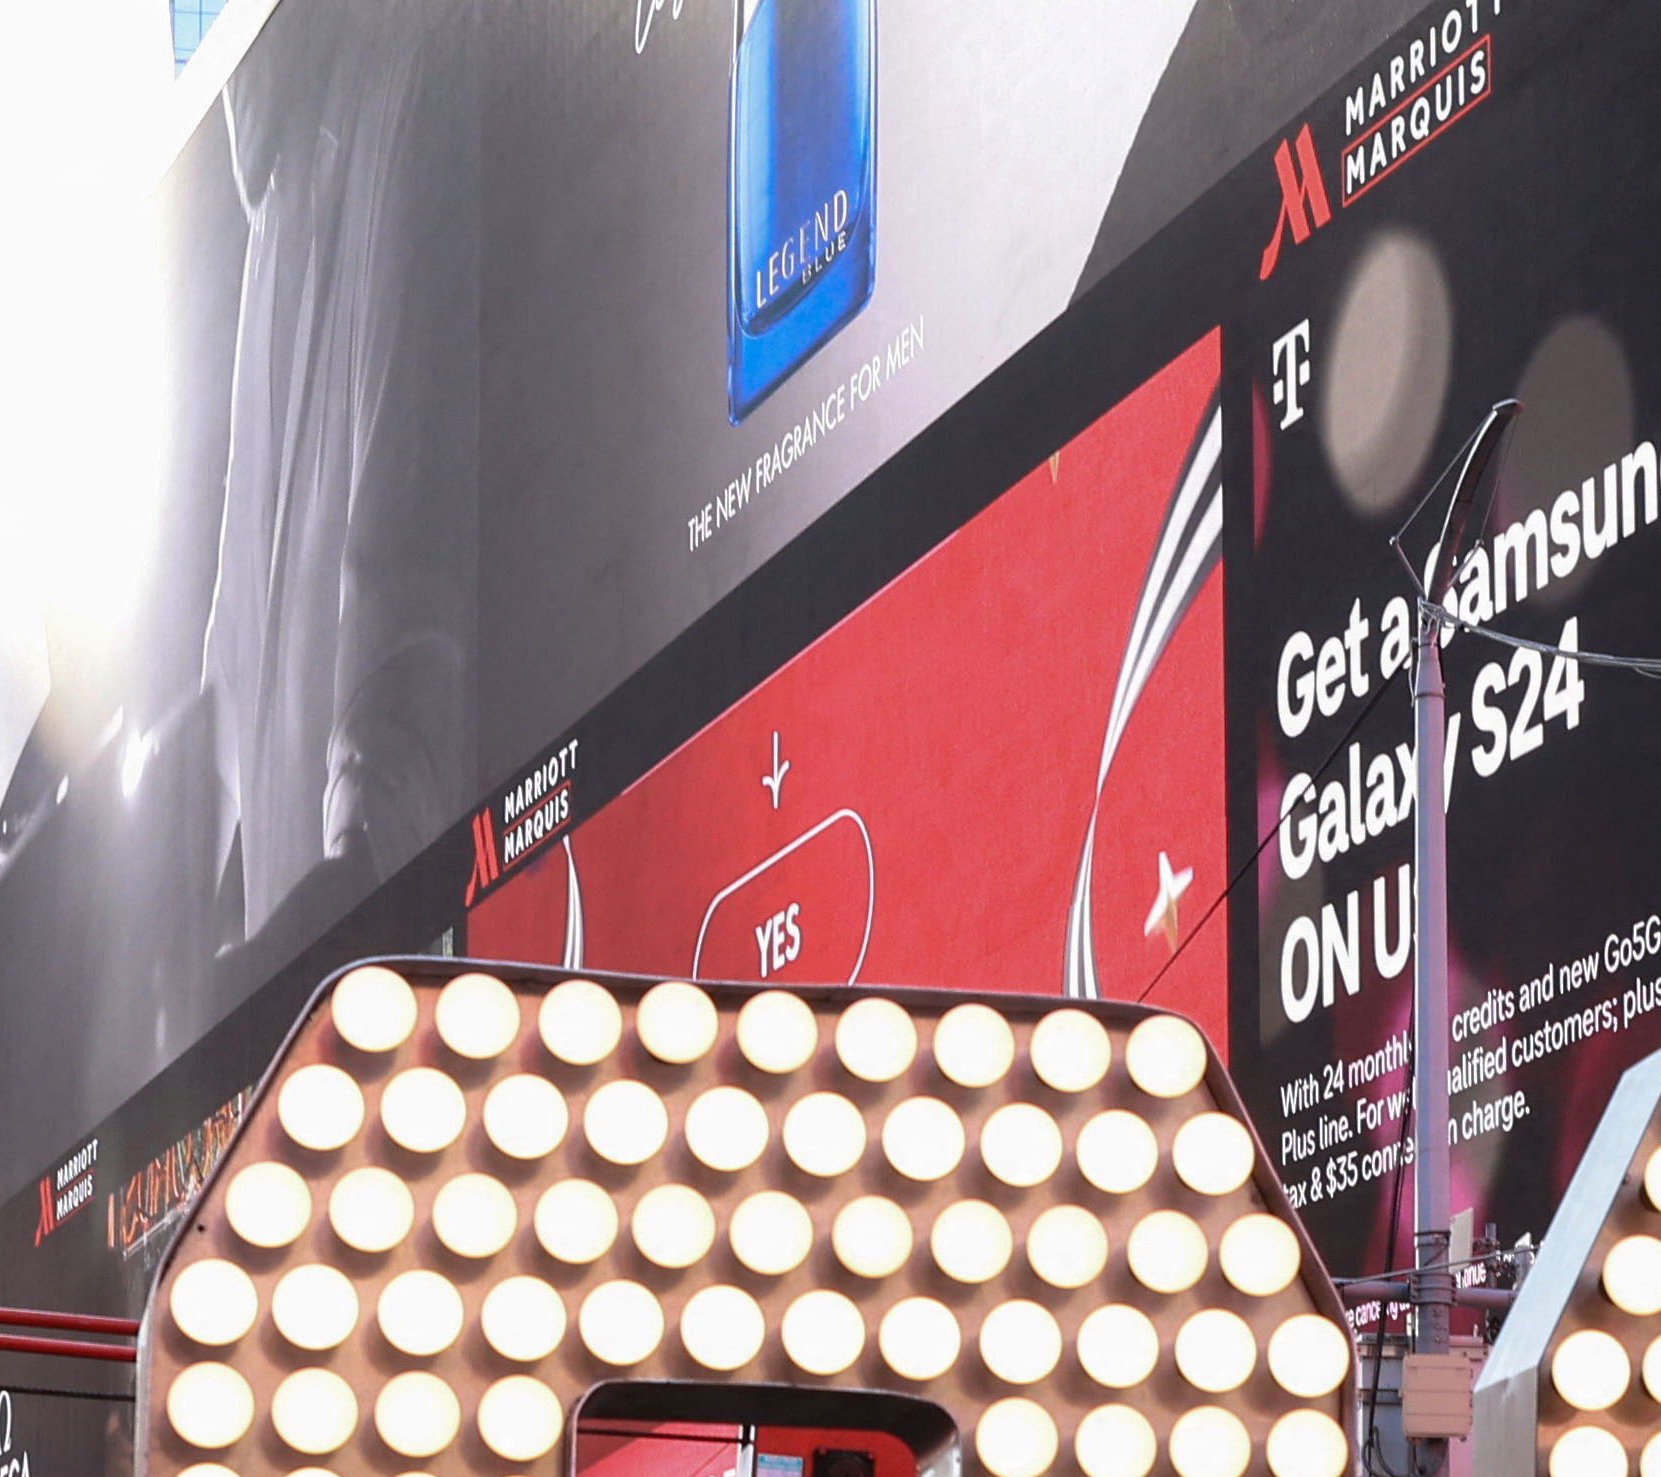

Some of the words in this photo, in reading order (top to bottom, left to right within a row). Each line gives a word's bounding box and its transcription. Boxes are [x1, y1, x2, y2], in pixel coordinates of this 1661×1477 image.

[1345, 0, 1502, 136] MARRIOT
[1345, 49, 1487, 195] MARQUIS
[755, 189, 848, 309] LEGEND
[802, 230, 847, 286] BLUE
[687, 502, 713, 553] THE
[715, 466, 752, 529] NEW
[755, 384, 846, 494] FRAGRANCE
[850, 354, 881, 412] FOR
[886, 313, 924, 381] MEN
[1277, 597, 1370, 739] Get
[1379, 595, 1413, 681] a
[1470, 615, 1585, 778] S24
[504, 738, 579, 824] MARRIOTT
[504, 788, 570, 864] MARQUIS
[755, 902, 802, 978] YES
[1280, 889, 1360, 1024] ON
[1373, 863, 1417, 980] U
[1280, 1063, 1320, 1119] With
[1322, 1057, 1345, 1100] 24
[1348, 1030, 1412, 1089] monthl
[1452, 989, 1516, 1043] credits
[1519, 961, 1554, 1012] and
[1559, 951, 1600, 994] new
[1604, 914, 1661, 975] Go5G
[1281, 1122, 1316, 1168] Plus
[1319, 1113, 1353, 1148] line.
[1356, 1097, 1385, 1135] For
[1511, 1000, 1620, 1068] customers;
[1310, 1167, 1324, 1203] &
[1326, 1149, 1359, 1197] $35
[1462, 1087, 1531, 1141] charge.
[55, 1174, 94, 1221] MARQUIS
[56, 1138, 99, 1191] MARRIOTT
